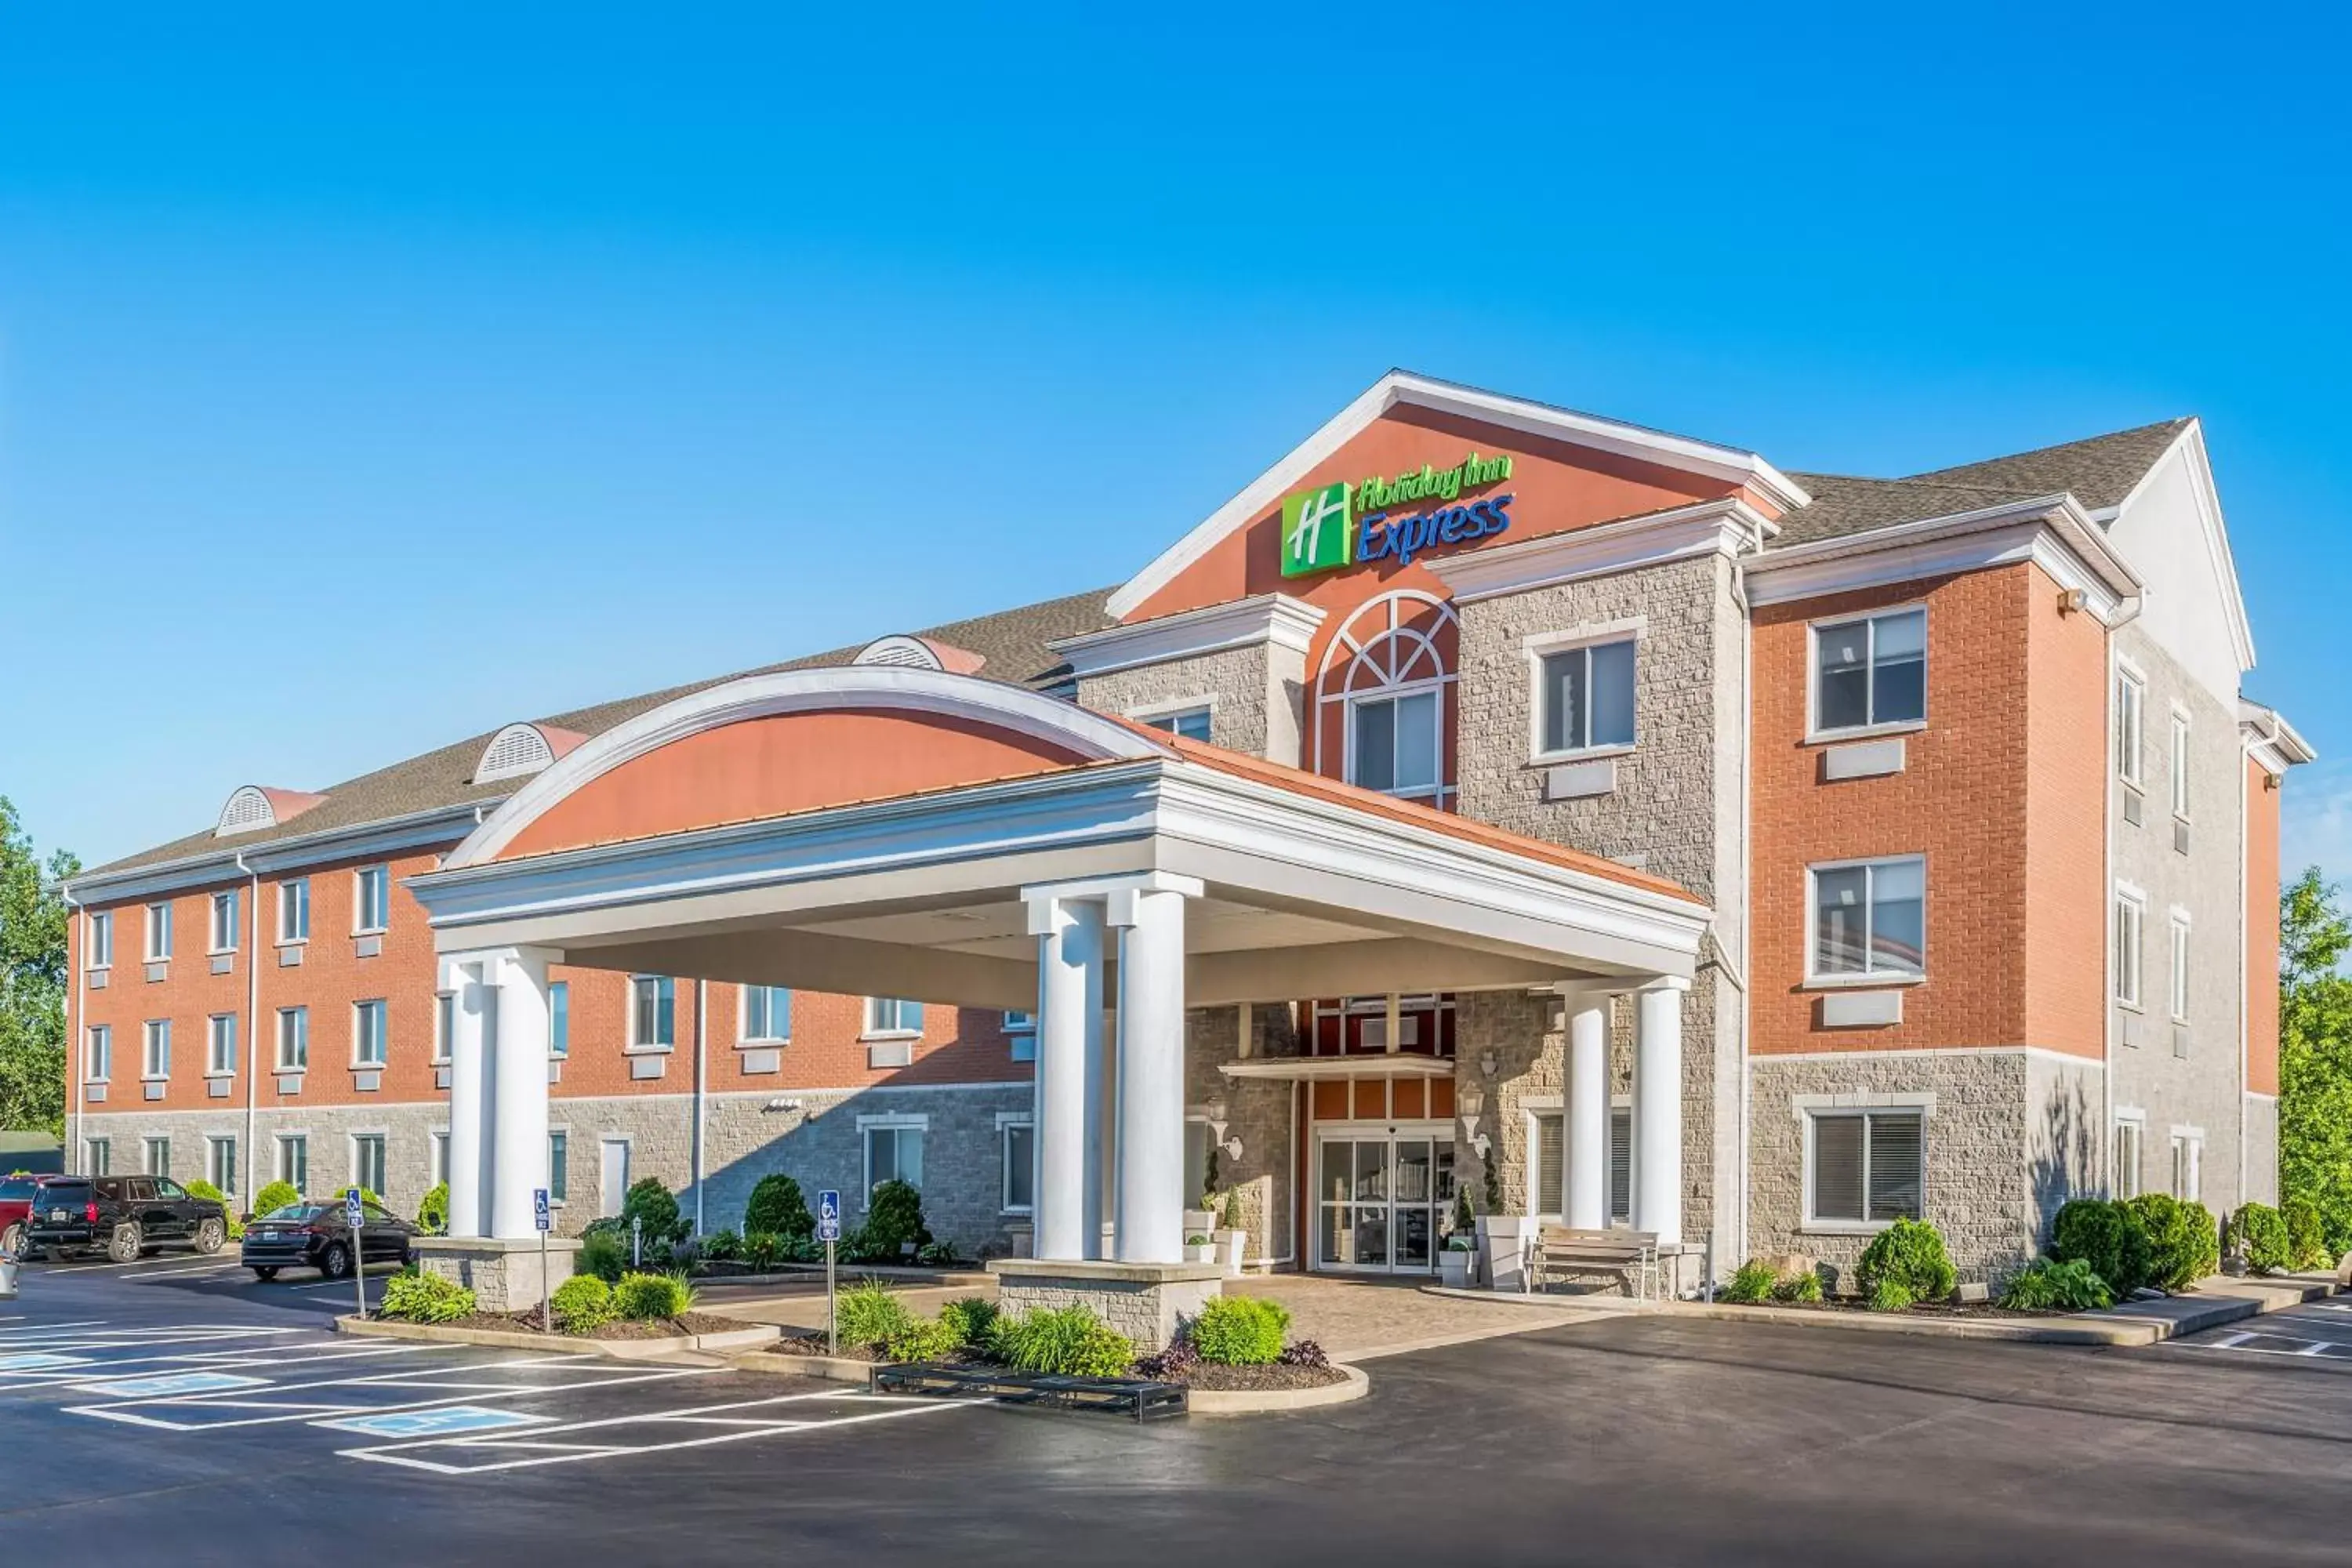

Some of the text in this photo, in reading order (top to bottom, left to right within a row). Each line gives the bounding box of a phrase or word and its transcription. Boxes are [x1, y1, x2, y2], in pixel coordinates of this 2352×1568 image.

[1356, 452, 1512, 512] Holiday Inn
[1287, 490, 1345, 565] H
[1356, 492, 1516, 566] Express
